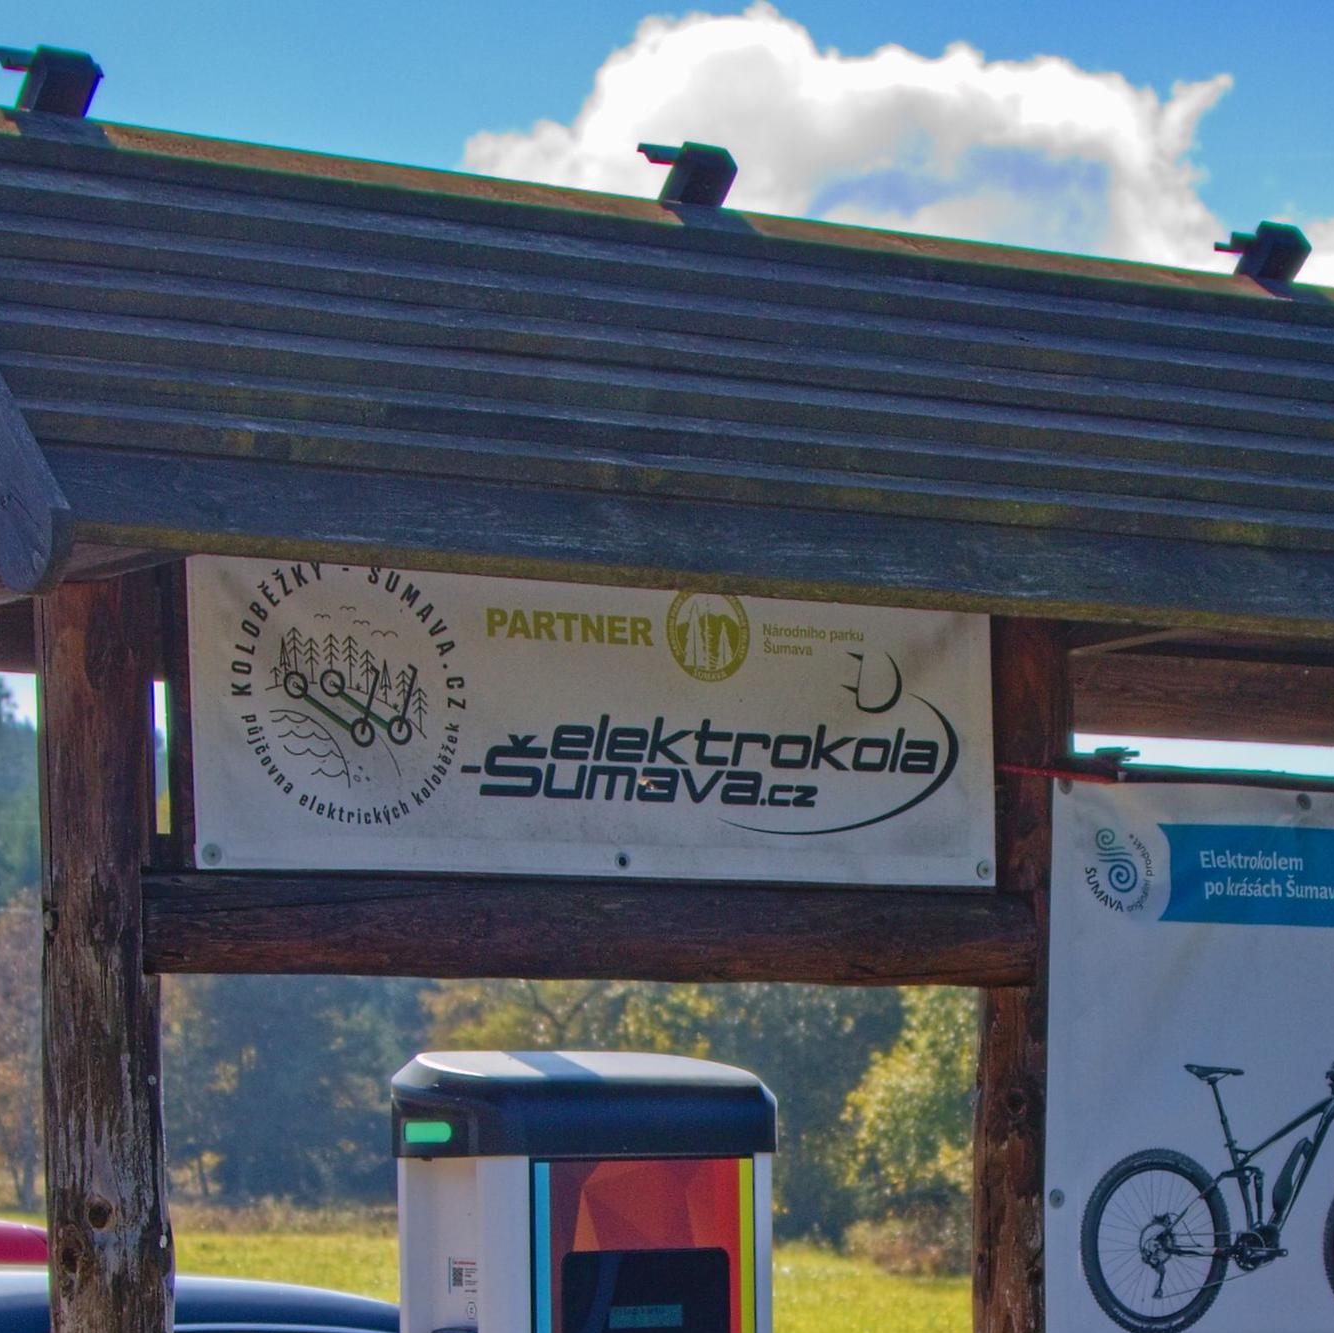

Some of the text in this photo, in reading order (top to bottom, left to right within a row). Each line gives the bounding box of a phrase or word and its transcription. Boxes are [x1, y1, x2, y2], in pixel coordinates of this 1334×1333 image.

[485, 607, 655, 647] PARTNER
[829, 629, 865, 646] parku
[763, 640, 813, 657] Šumava
[550, 714, 940, 774] elektrokola
[241, 714, 460, 825] půjčovna elektrických koloběžek
[1199, 850, 1304, 871] Elektrokolem
[1204, 880, 1224, 899] po
[1226, 876, 1283, 898] krásách
